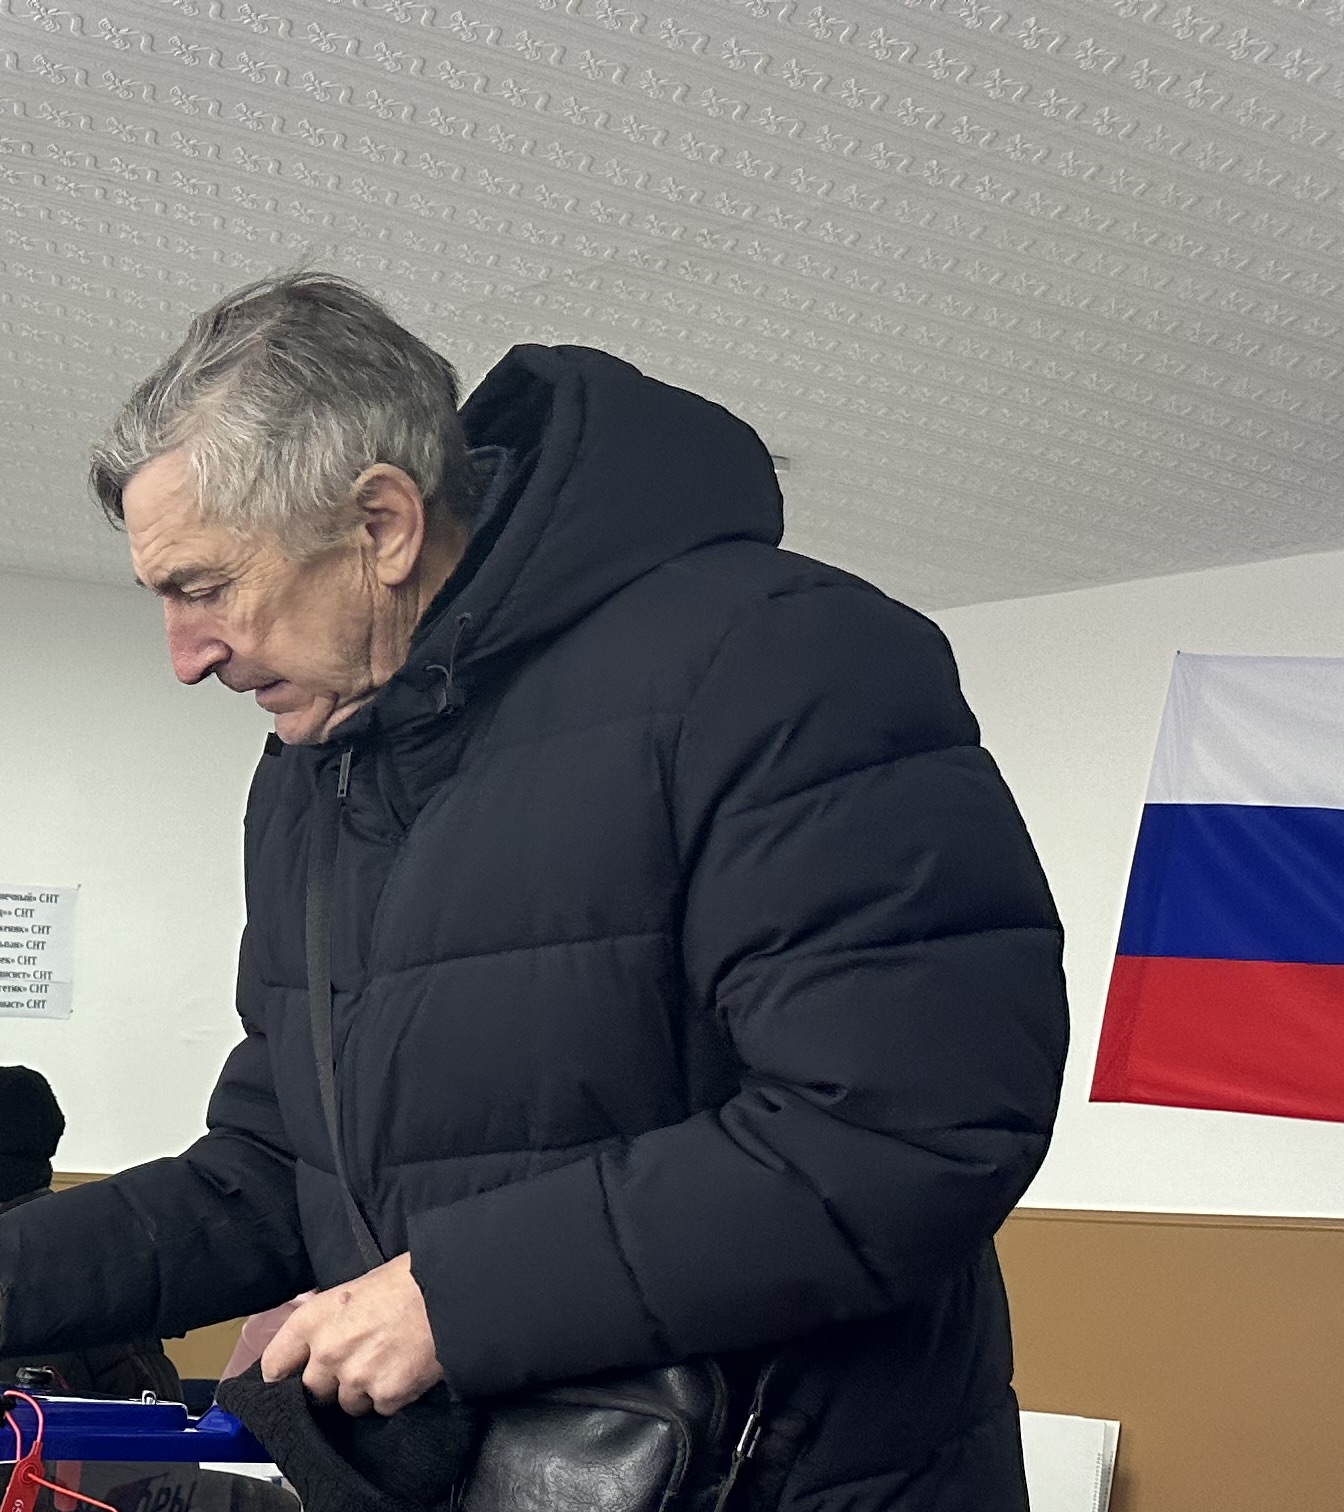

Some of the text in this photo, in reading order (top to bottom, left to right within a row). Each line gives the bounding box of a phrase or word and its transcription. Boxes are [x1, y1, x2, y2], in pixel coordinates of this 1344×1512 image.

[38, 893, 60, 904] СНТ
[14, 907, 35, 918] СНТ
[30, 924, 51, 935] СНТ
[25, 940, 47, 951] СНТ
[17, 955, 37, 966] СНТ
[32, 970, 53, 981] СНТ
[29, 983, 49, 993] СНТ
[26, 998, 47, 1009] СНТ
